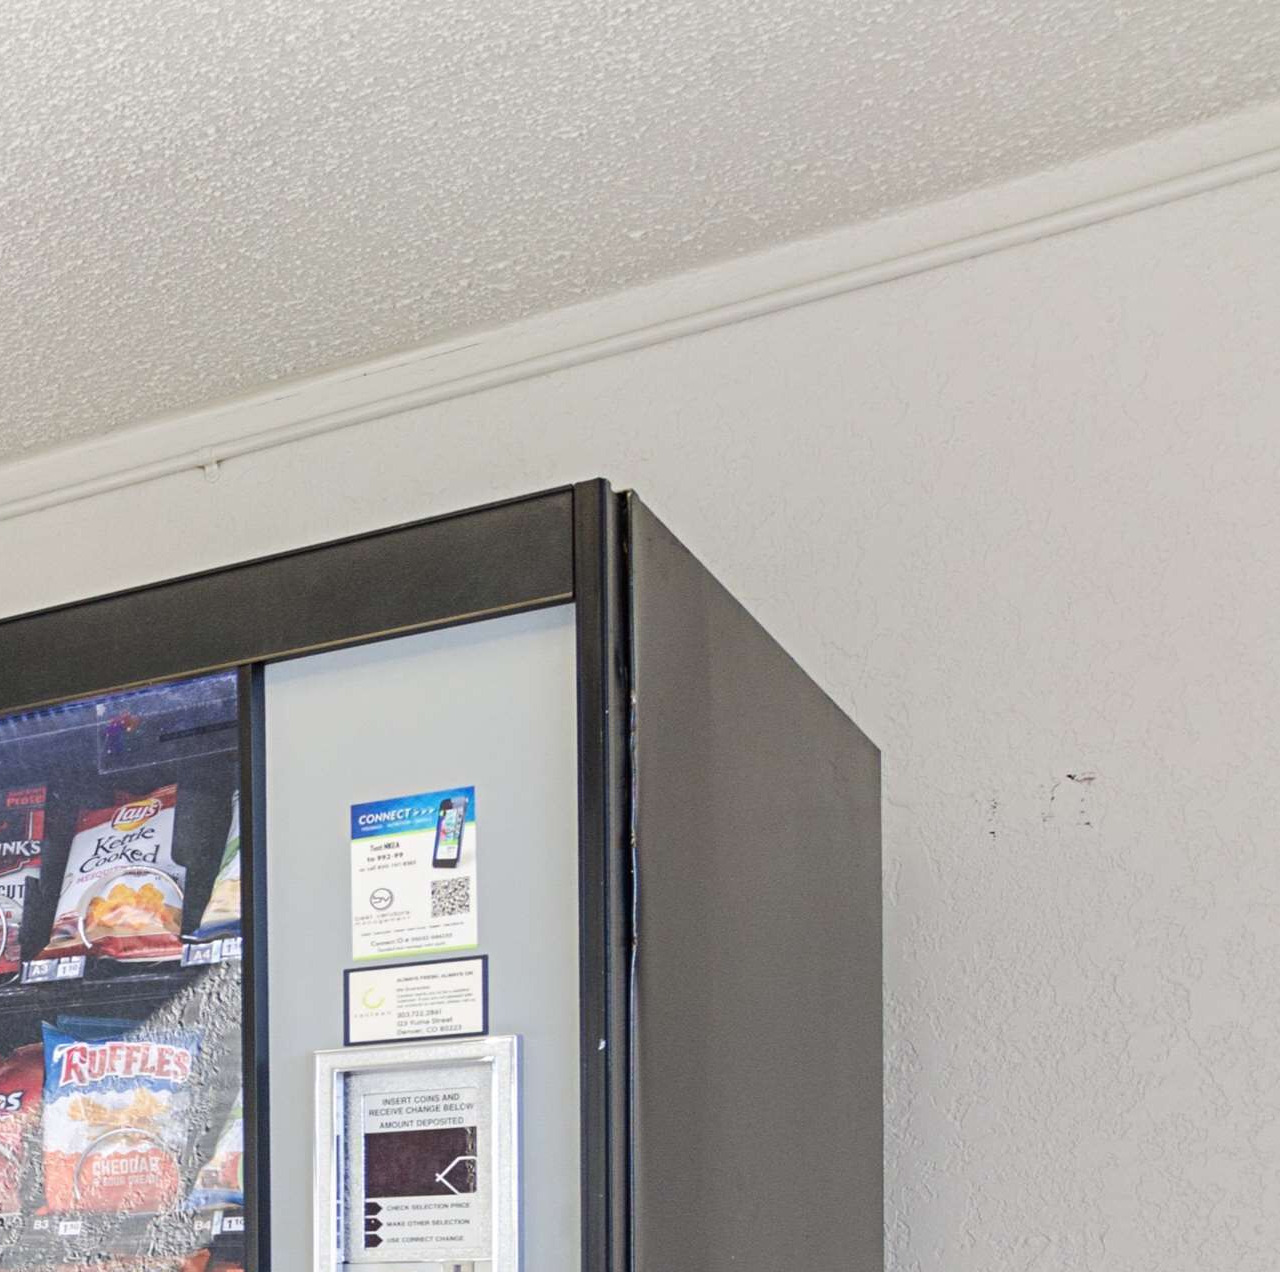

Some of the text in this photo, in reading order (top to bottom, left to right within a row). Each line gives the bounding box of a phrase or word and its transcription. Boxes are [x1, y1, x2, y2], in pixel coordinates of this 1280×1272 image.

[358, 808, 411, 826] CONNECT
[93, 826, 156, 857] Kettle
[79, 843, 160, 874] Cooked
[54, 1041, 192, 1087] RUFFLES
[383, 1092, 461, 1106] INSERT COINS AND
[368, 1102, 474, 1116] RECEIVE CHANGE BELOW
[379, 1116, 465, 1130] AMOUNT DEPOSITED
[92, 1156, 161, 1175] CHEDDAR
[411, 1203, 449, 1211] SELECTION
[33, 1220, 49, 1230] B3
[194, 1220, 211, 1231] B4
[407, 1219, 430, 1227] OTHER
[431, 1218, 471, 1226] SELECTION
[435, 1234, 464, 1242] CHANGE
